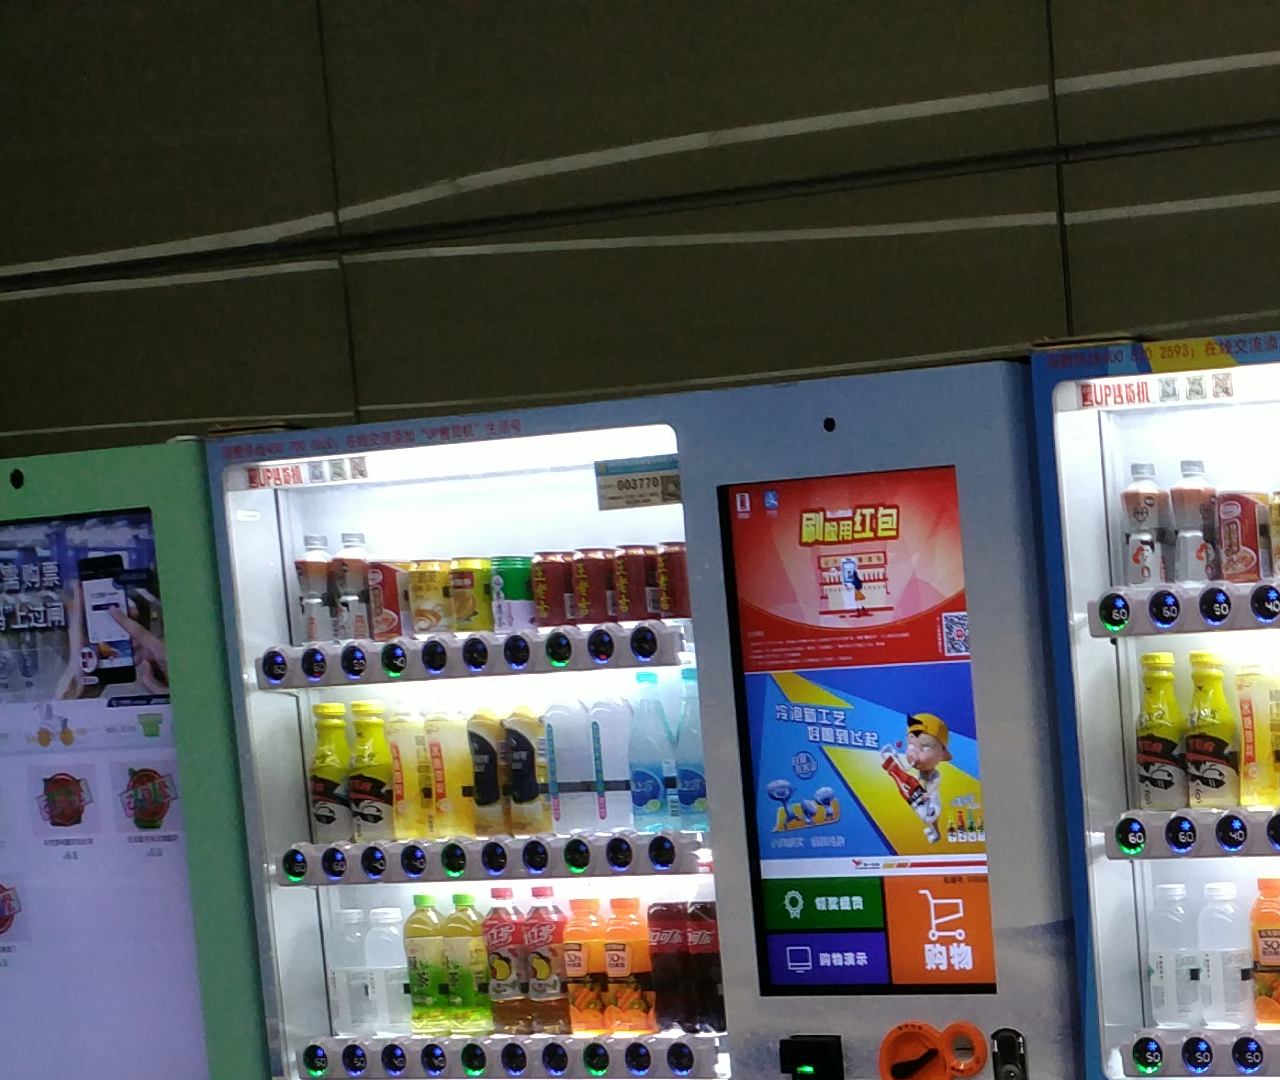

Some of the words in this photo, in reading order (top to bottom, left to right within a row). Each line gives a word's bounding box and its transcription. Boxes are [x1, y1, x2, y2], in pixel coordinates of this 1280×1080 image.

[819, 951, 869, 967] 购物演示
[924, 943, 974, 972] 购物
